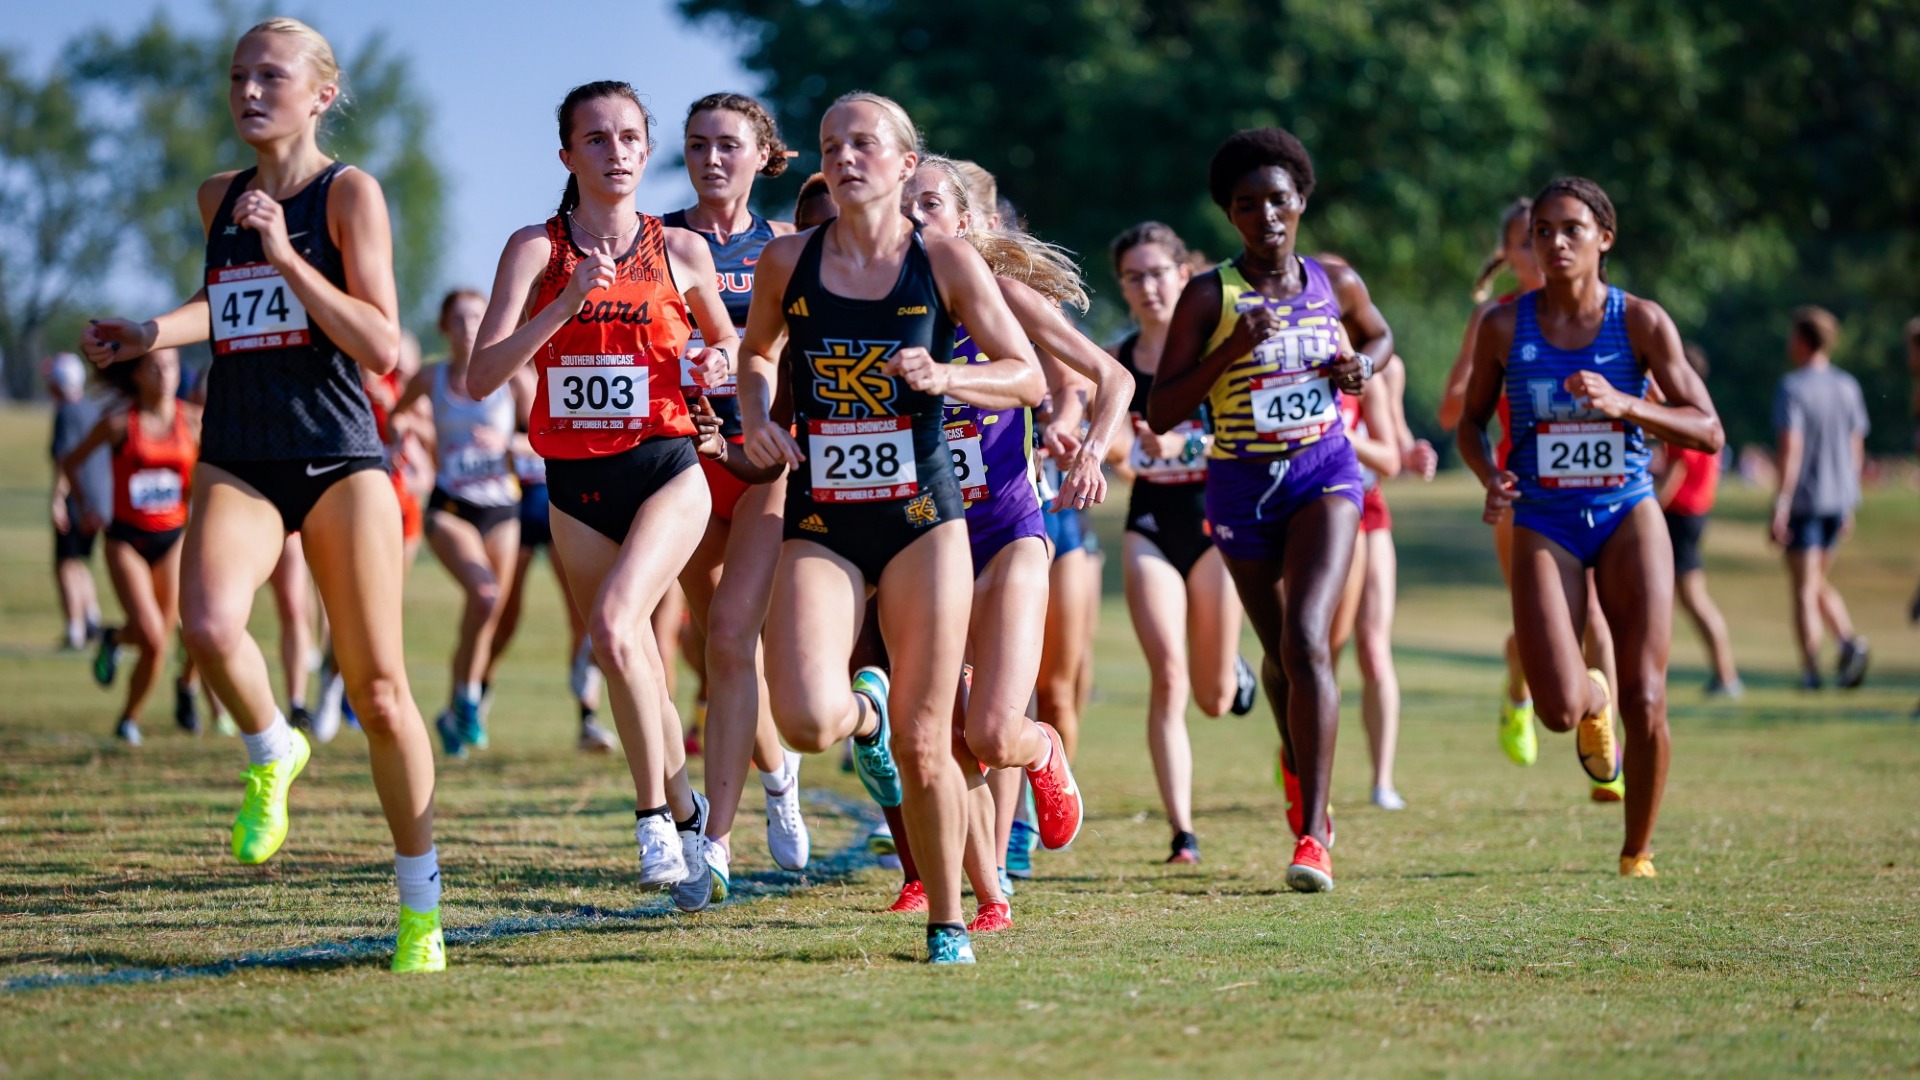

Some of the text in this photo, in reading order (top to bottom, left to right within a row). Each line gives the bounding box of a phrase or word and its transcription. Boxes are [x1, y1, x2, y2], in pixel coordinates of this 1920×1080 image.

[221, 286, 290, 328] 474
[564, 300, 652, 326] ears
[561, 354, 634, 366] SOUTHERN SHOWCASE
[563, 375, 634, 410] 303
[1267, 388, 1325, 423] 432
[572, 420, 602, 429] SEPTEMBER
[820, 420, 898, 435] SOUTHERN SHOWCASE
[824, 442, 899, 480] 238
[1551, 441, 1612, 469] 248
[834, 489, 868, 500] SEPTEMBER
[799, 522, 828, 533] adidas
